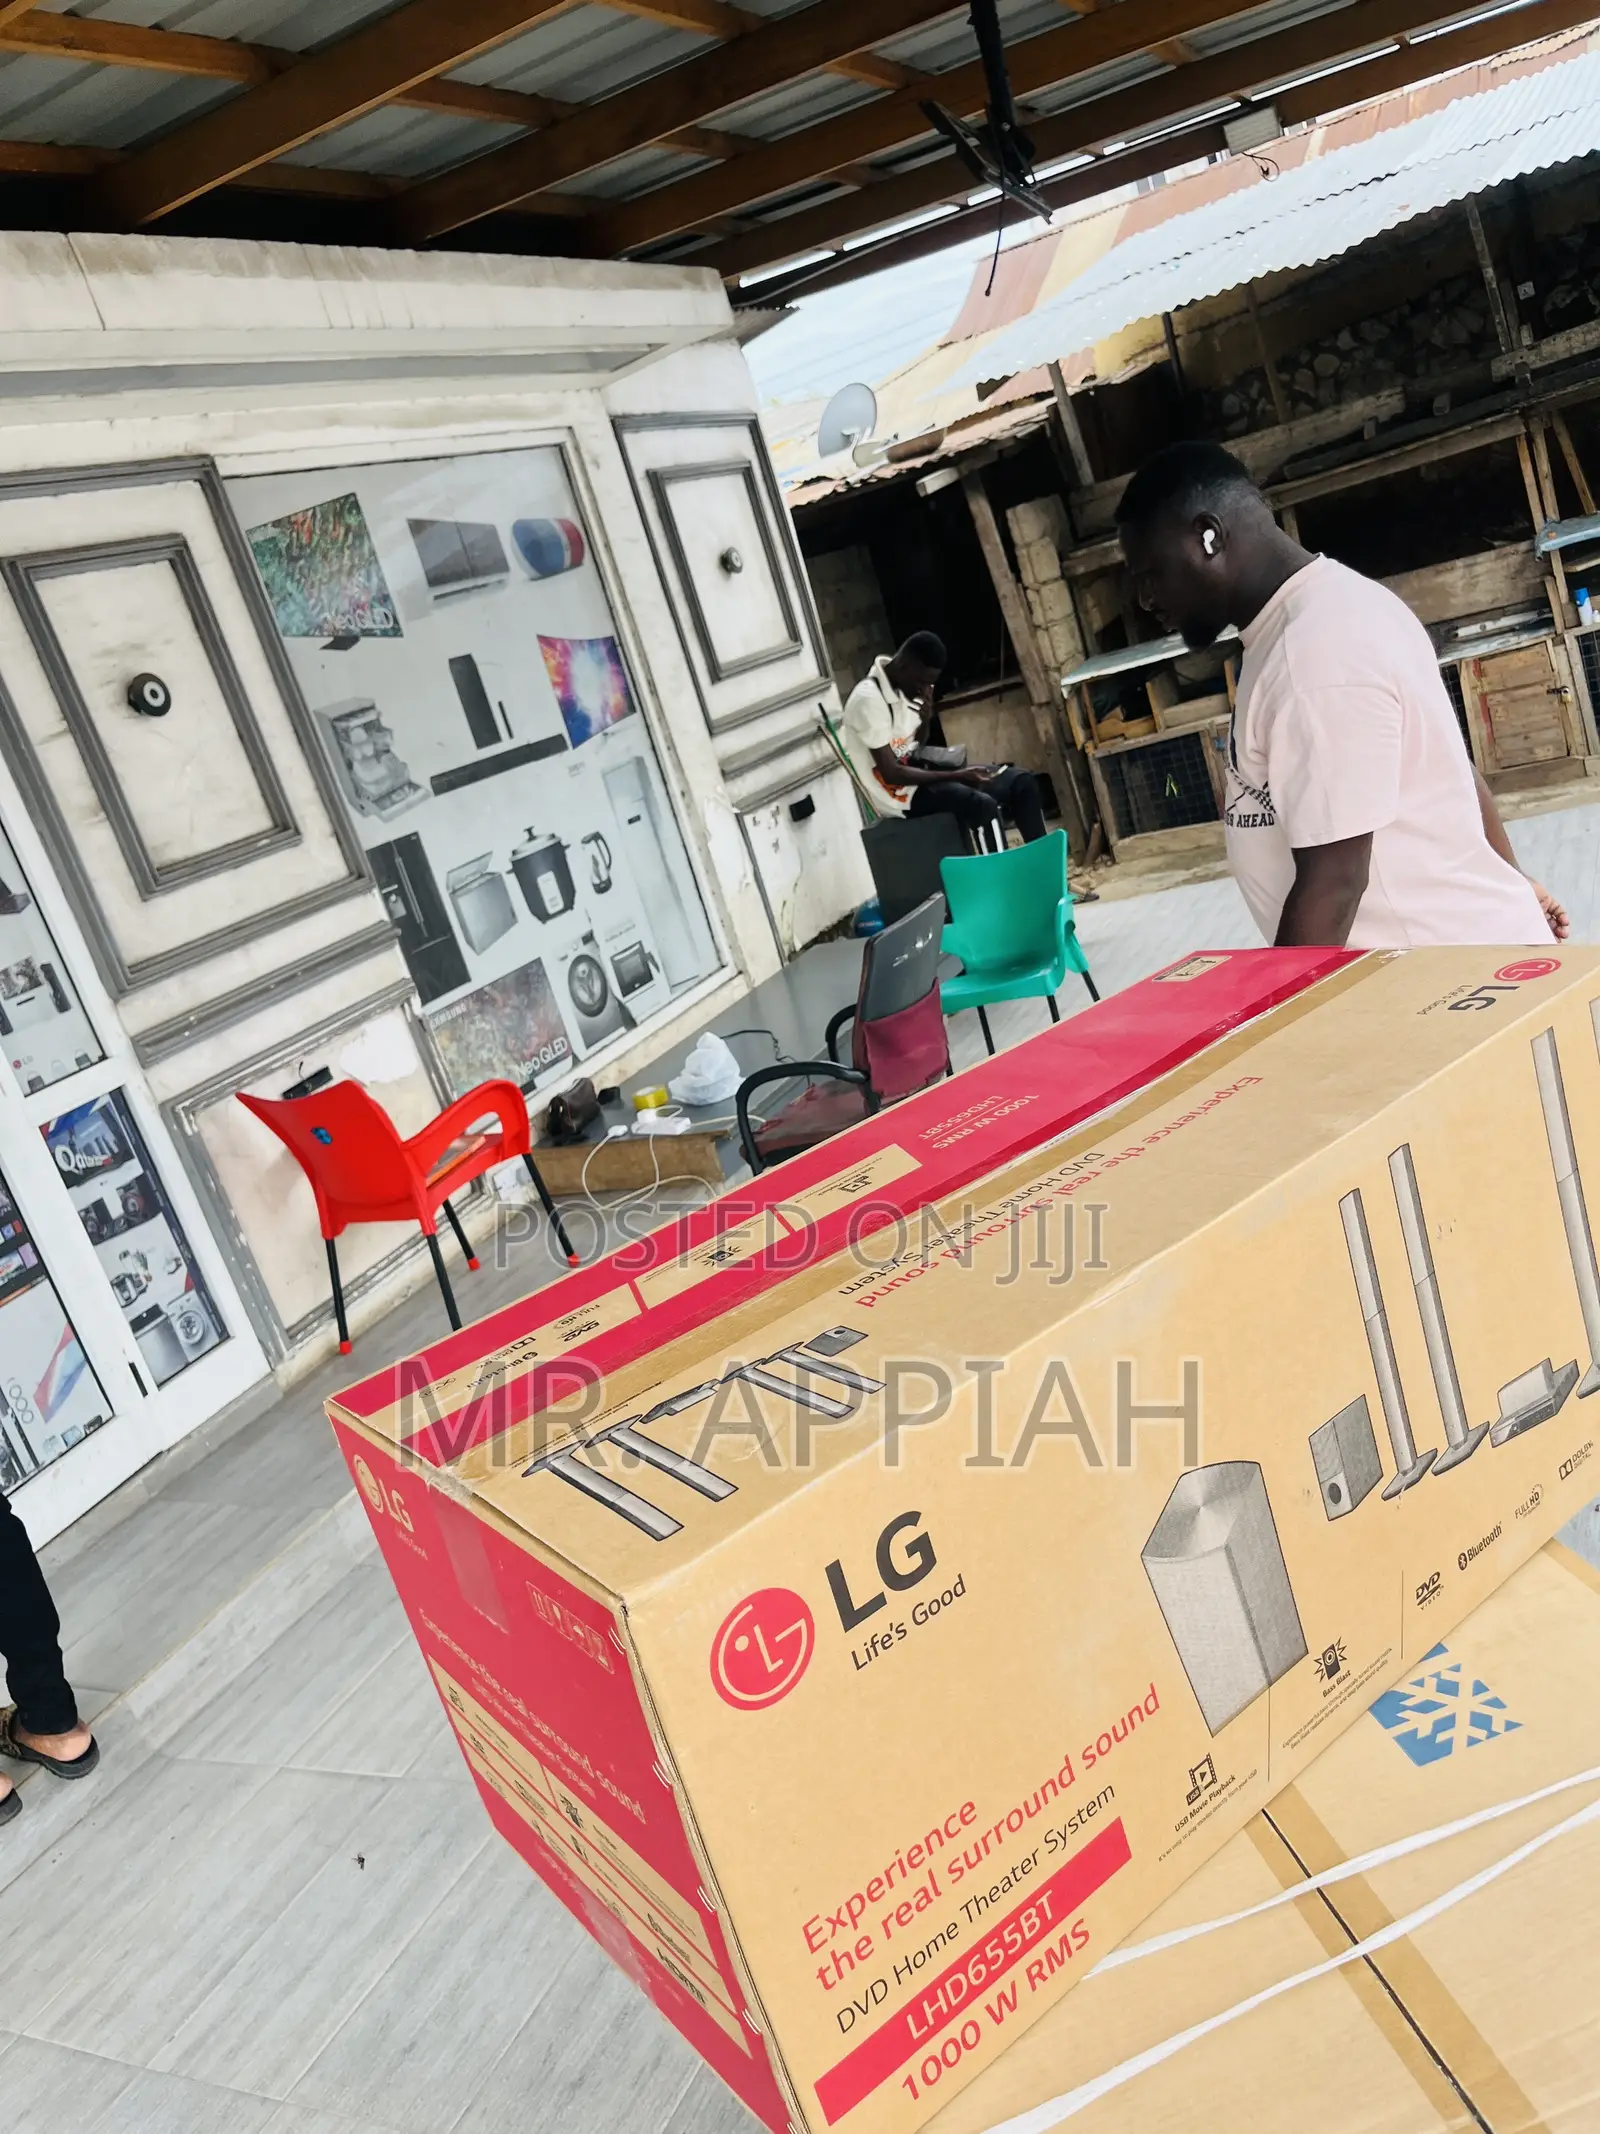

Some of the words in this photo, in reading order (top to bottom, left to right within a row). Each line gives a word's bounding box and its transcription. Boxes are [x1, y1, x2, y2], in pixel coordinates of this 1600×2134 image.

[1236, 812, 1275, 828] AHEAD
[1447, 985, 1520, 1011] LG
[515, 1056, 541, 1079] Neo
[538, 1036, 569, 1065] QLED
[919, 1095, 1003, 1140] LHD655BT
[974, 1115, 997, 1129] W
[994, 1094, 1040, 1116] 1000
[1142, 1076, 1263, 1144] Experience
[932, 1127, 975, 1149] RMS
[1101, 1146, 1146, 1168] the
[1052, 1171, 1102, 1196] real
[1059, 1152, 1106, 1177] DVD
[999, 1176, 1062, 1209] Home
[924, 1211, 1006, 1251] Theater
[940, 1197, 1054, 1259] surround
[838, 1252, 923, 1295] System
[855, 1260, 940, 1308] sound
[564, 1322, 600, 1342] DVD
[467, 1357, 524, 1389] Bluetooth
[1572, 1440, 1593, 1463] DOLBY
[379, 1476, 415, 1533] LG
[1515, 1501, 1530, 1519] FULL
[1529, 1491, 1540, 1507] HD
[1467, 1524, 1502, 1562] Bluetooth
[825, 1510, 937, 1633] LG
[1416, 1571, 1441, 1600] DVD
[1420, 1590, 1441, 1611] VIDEO
[851, 1622, 908, 1671] Life's
[911, 1573, 967, 1626] Good
[1322, 1683, 1337, 1698] Bass
[1336, 1669, 1352, 1686] Blast
[1174, 1815, 1190, 1832] USB
[1189, 1799, 1209, 1820] Movie
[1208, 1774, 1237, 1802] Playback
[815, 1929, 875, 1991] the
[881, 1868, 943, 1941] real
[946, 1754, 1076, 1885] surround
[1080, 1682, 1161, 1770] sound
[801, 1800, 978, 1955] Experience
[835, 1978, 889, 2035] DVD
[892, 1921, 960, 1986] Home
[959, 1848, 1040, 1924] Theater
[1043, 1784, 1116, 1855] System
[905, 1890, 1054, 2041] LHD655BT
[901, 2019, 981, 2101] 1000
[984, 1980, 1019, 2026] W
[1025, 1918, 1091, 1992] RMS
